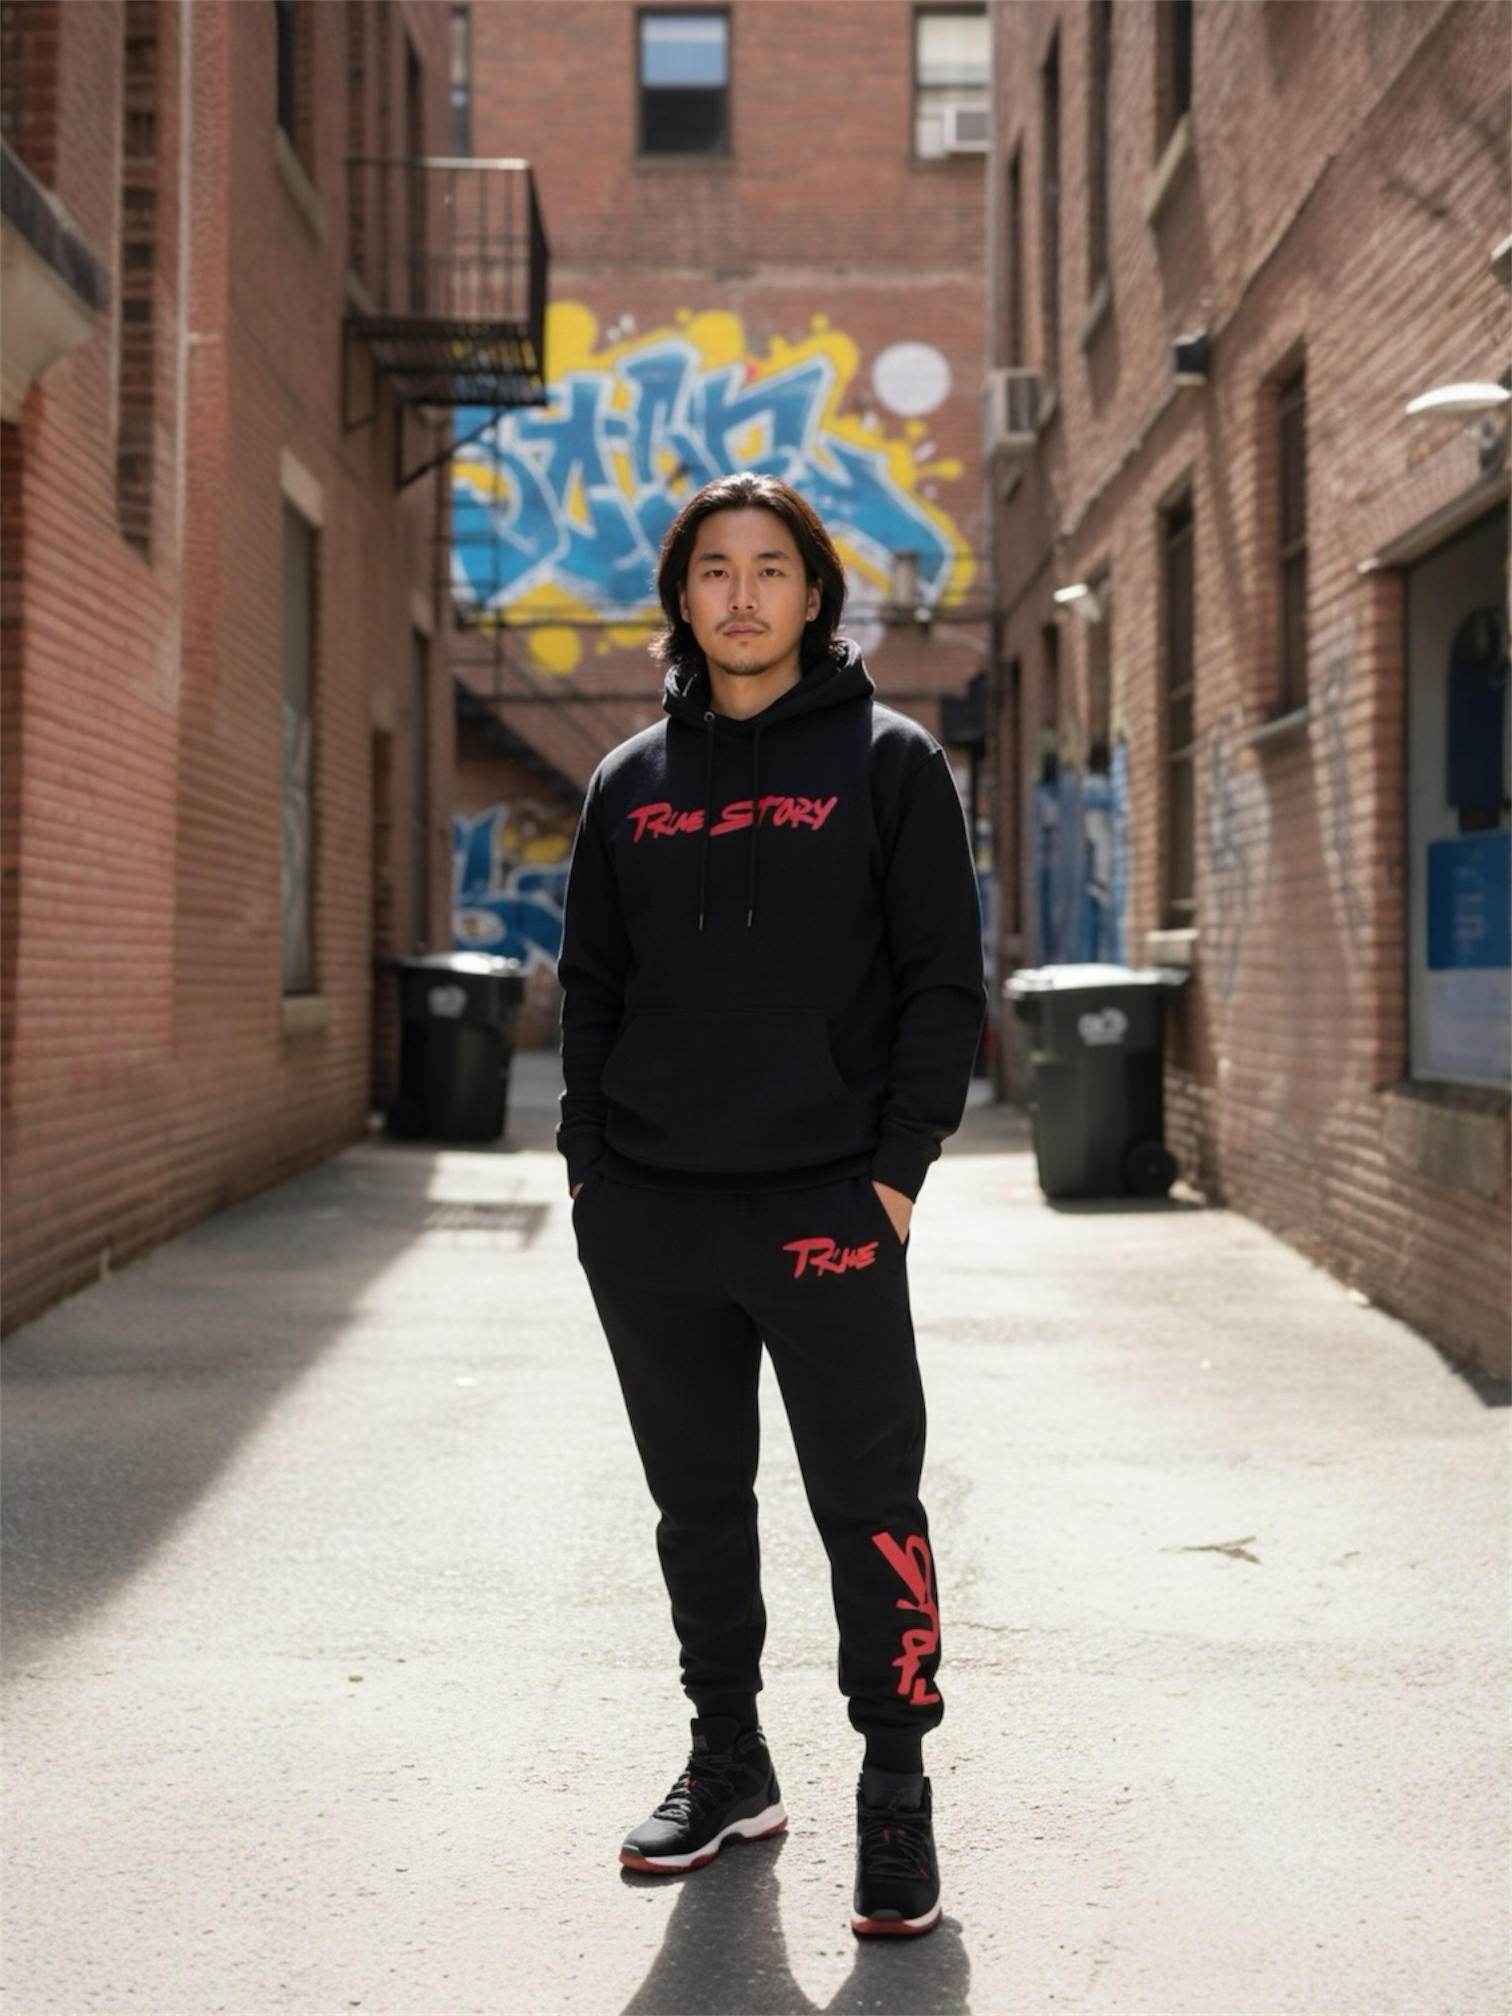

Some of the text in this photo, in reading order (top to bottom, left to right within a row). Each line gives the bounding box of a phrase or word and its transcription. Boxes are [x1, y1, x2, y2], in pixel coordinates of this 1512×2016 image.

[627, 795, 838, 843] TRUE STORY
[782, 1236, 879, 1279] TRUE
